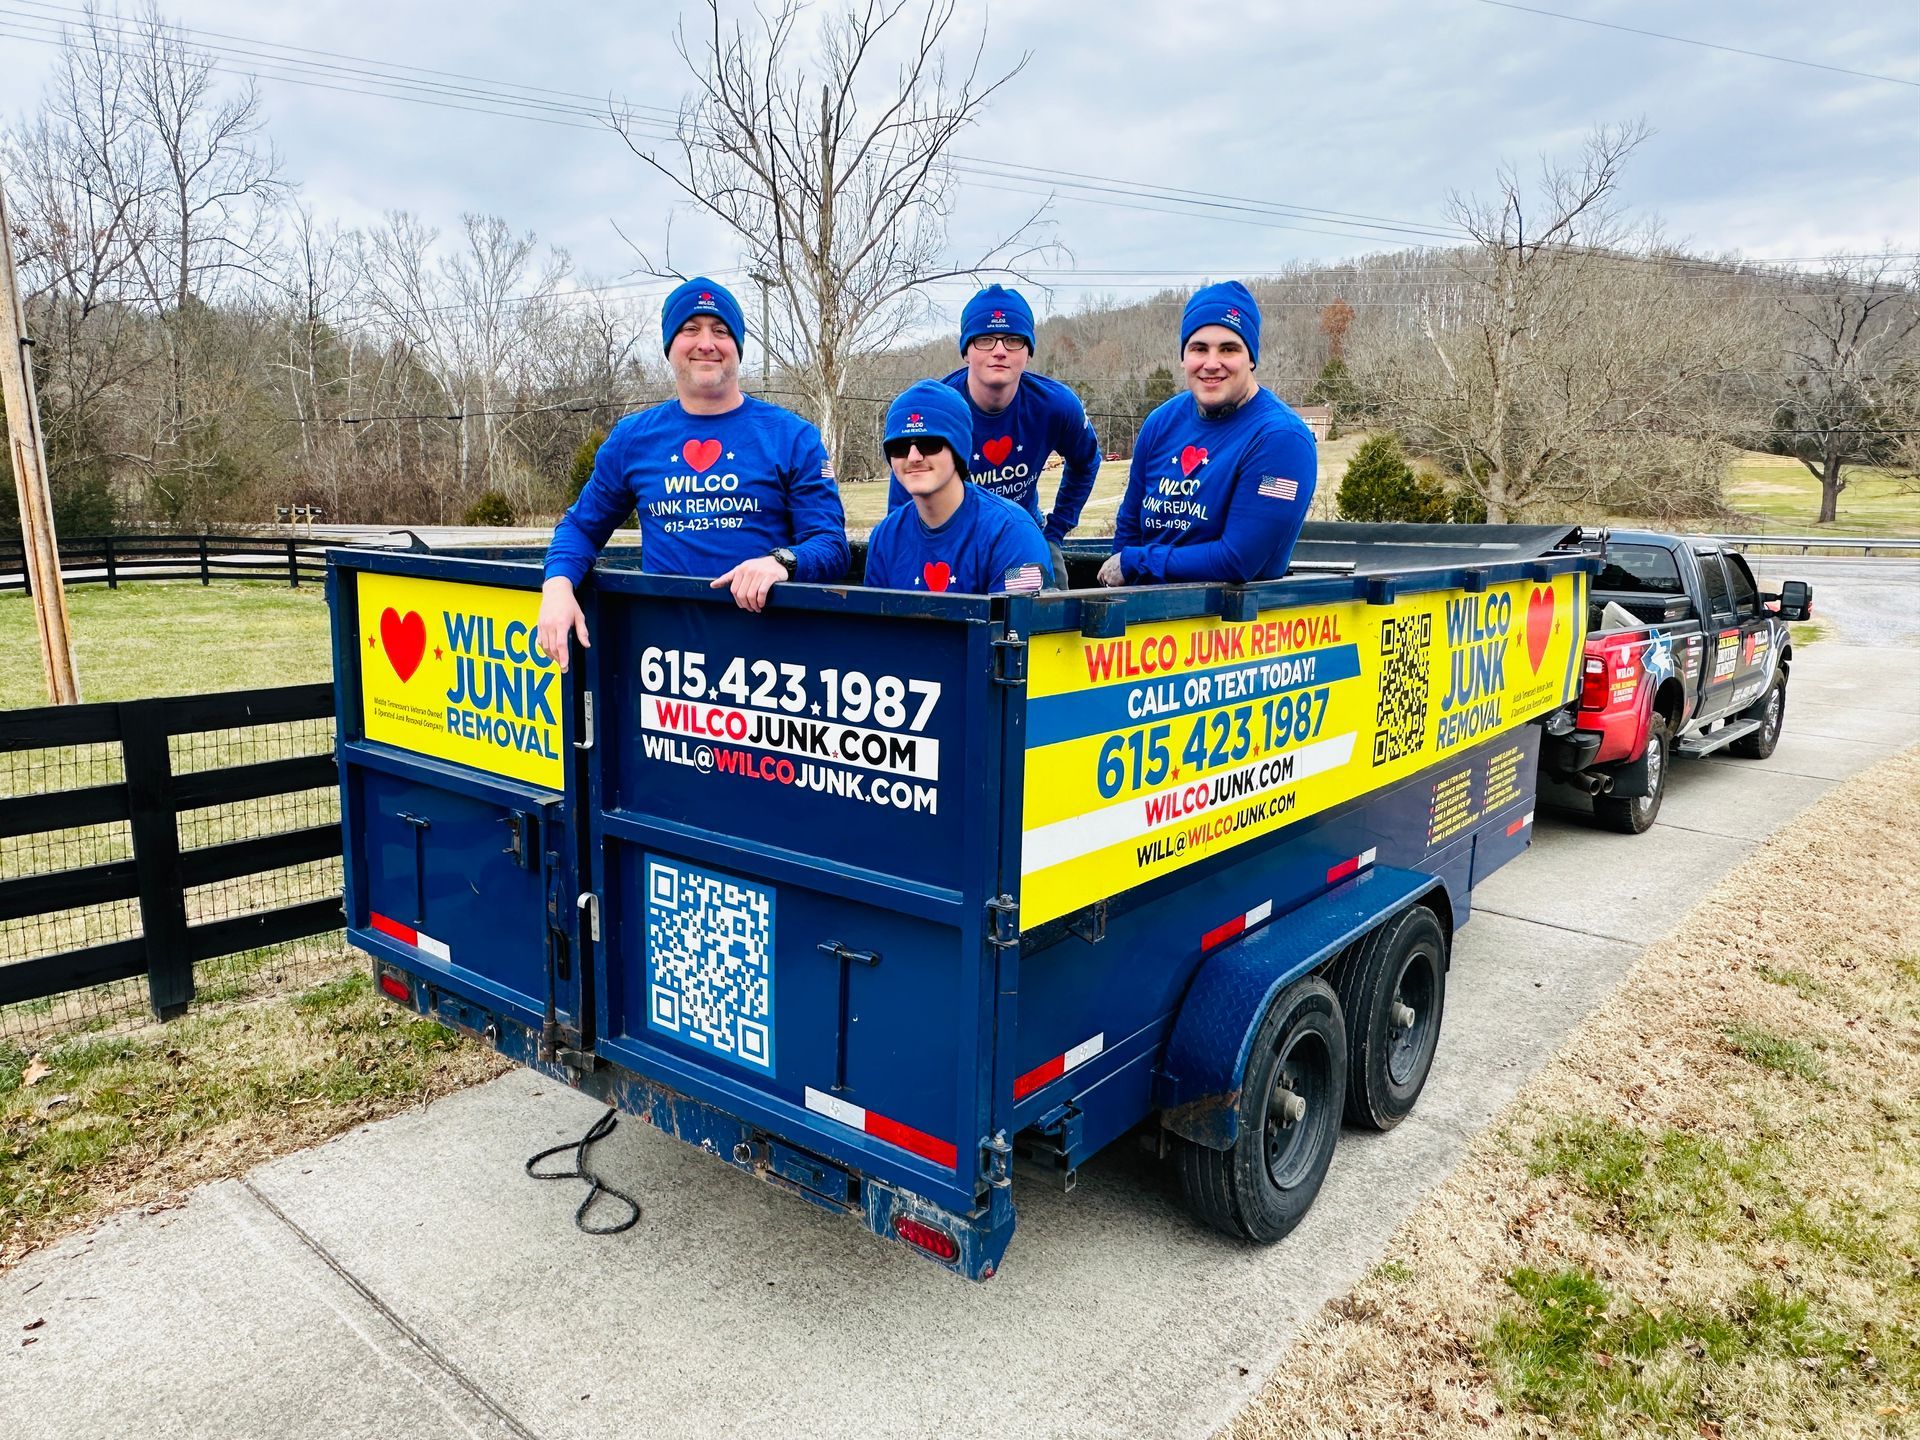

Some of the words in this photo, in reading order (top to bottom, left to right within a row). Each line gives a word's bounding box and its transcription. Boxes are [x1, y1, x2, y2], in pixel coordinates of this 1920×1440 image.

[664, 473, 739, 494] WILCO
[970, 463, 1029, 486] WILCO
[664, 517, 743, 533] 615-423-1987
[686, 497, 762, 514] REMOVAL
[443, 611, 555, 668] WILCO
[1084, 634, 1178, 683] WILCO
[1184, 625, 1246, 667] JUNK
[1250, 614, 1342, 657] REMOVAL
[1445, 591, 1512, 648] WILCO
[446, 655, 557, 726] JUNK
[1127, 688, 1181, 720] CALL
[1183, 678, 1211, 707] OR
[1214, 667, 1258, 700] TEXT
[1260, 656, 1317, 692] TODAY!
[1441, 638, 1509, 712] JUNK
[446, 706, 559, 760] REMOVAL
[654, 699, 917, 772] WILCOJUNK.COM
[1436, 697, 1503, 752] REMOVAL
[641, 733, 938, 815] WILL@WILCOJUNK.COM
[1145, 755, 1294, 827] WILCOJUNK.COM
[1136, 791, 1296, 868] WILL@WILCOJUNK.COM
